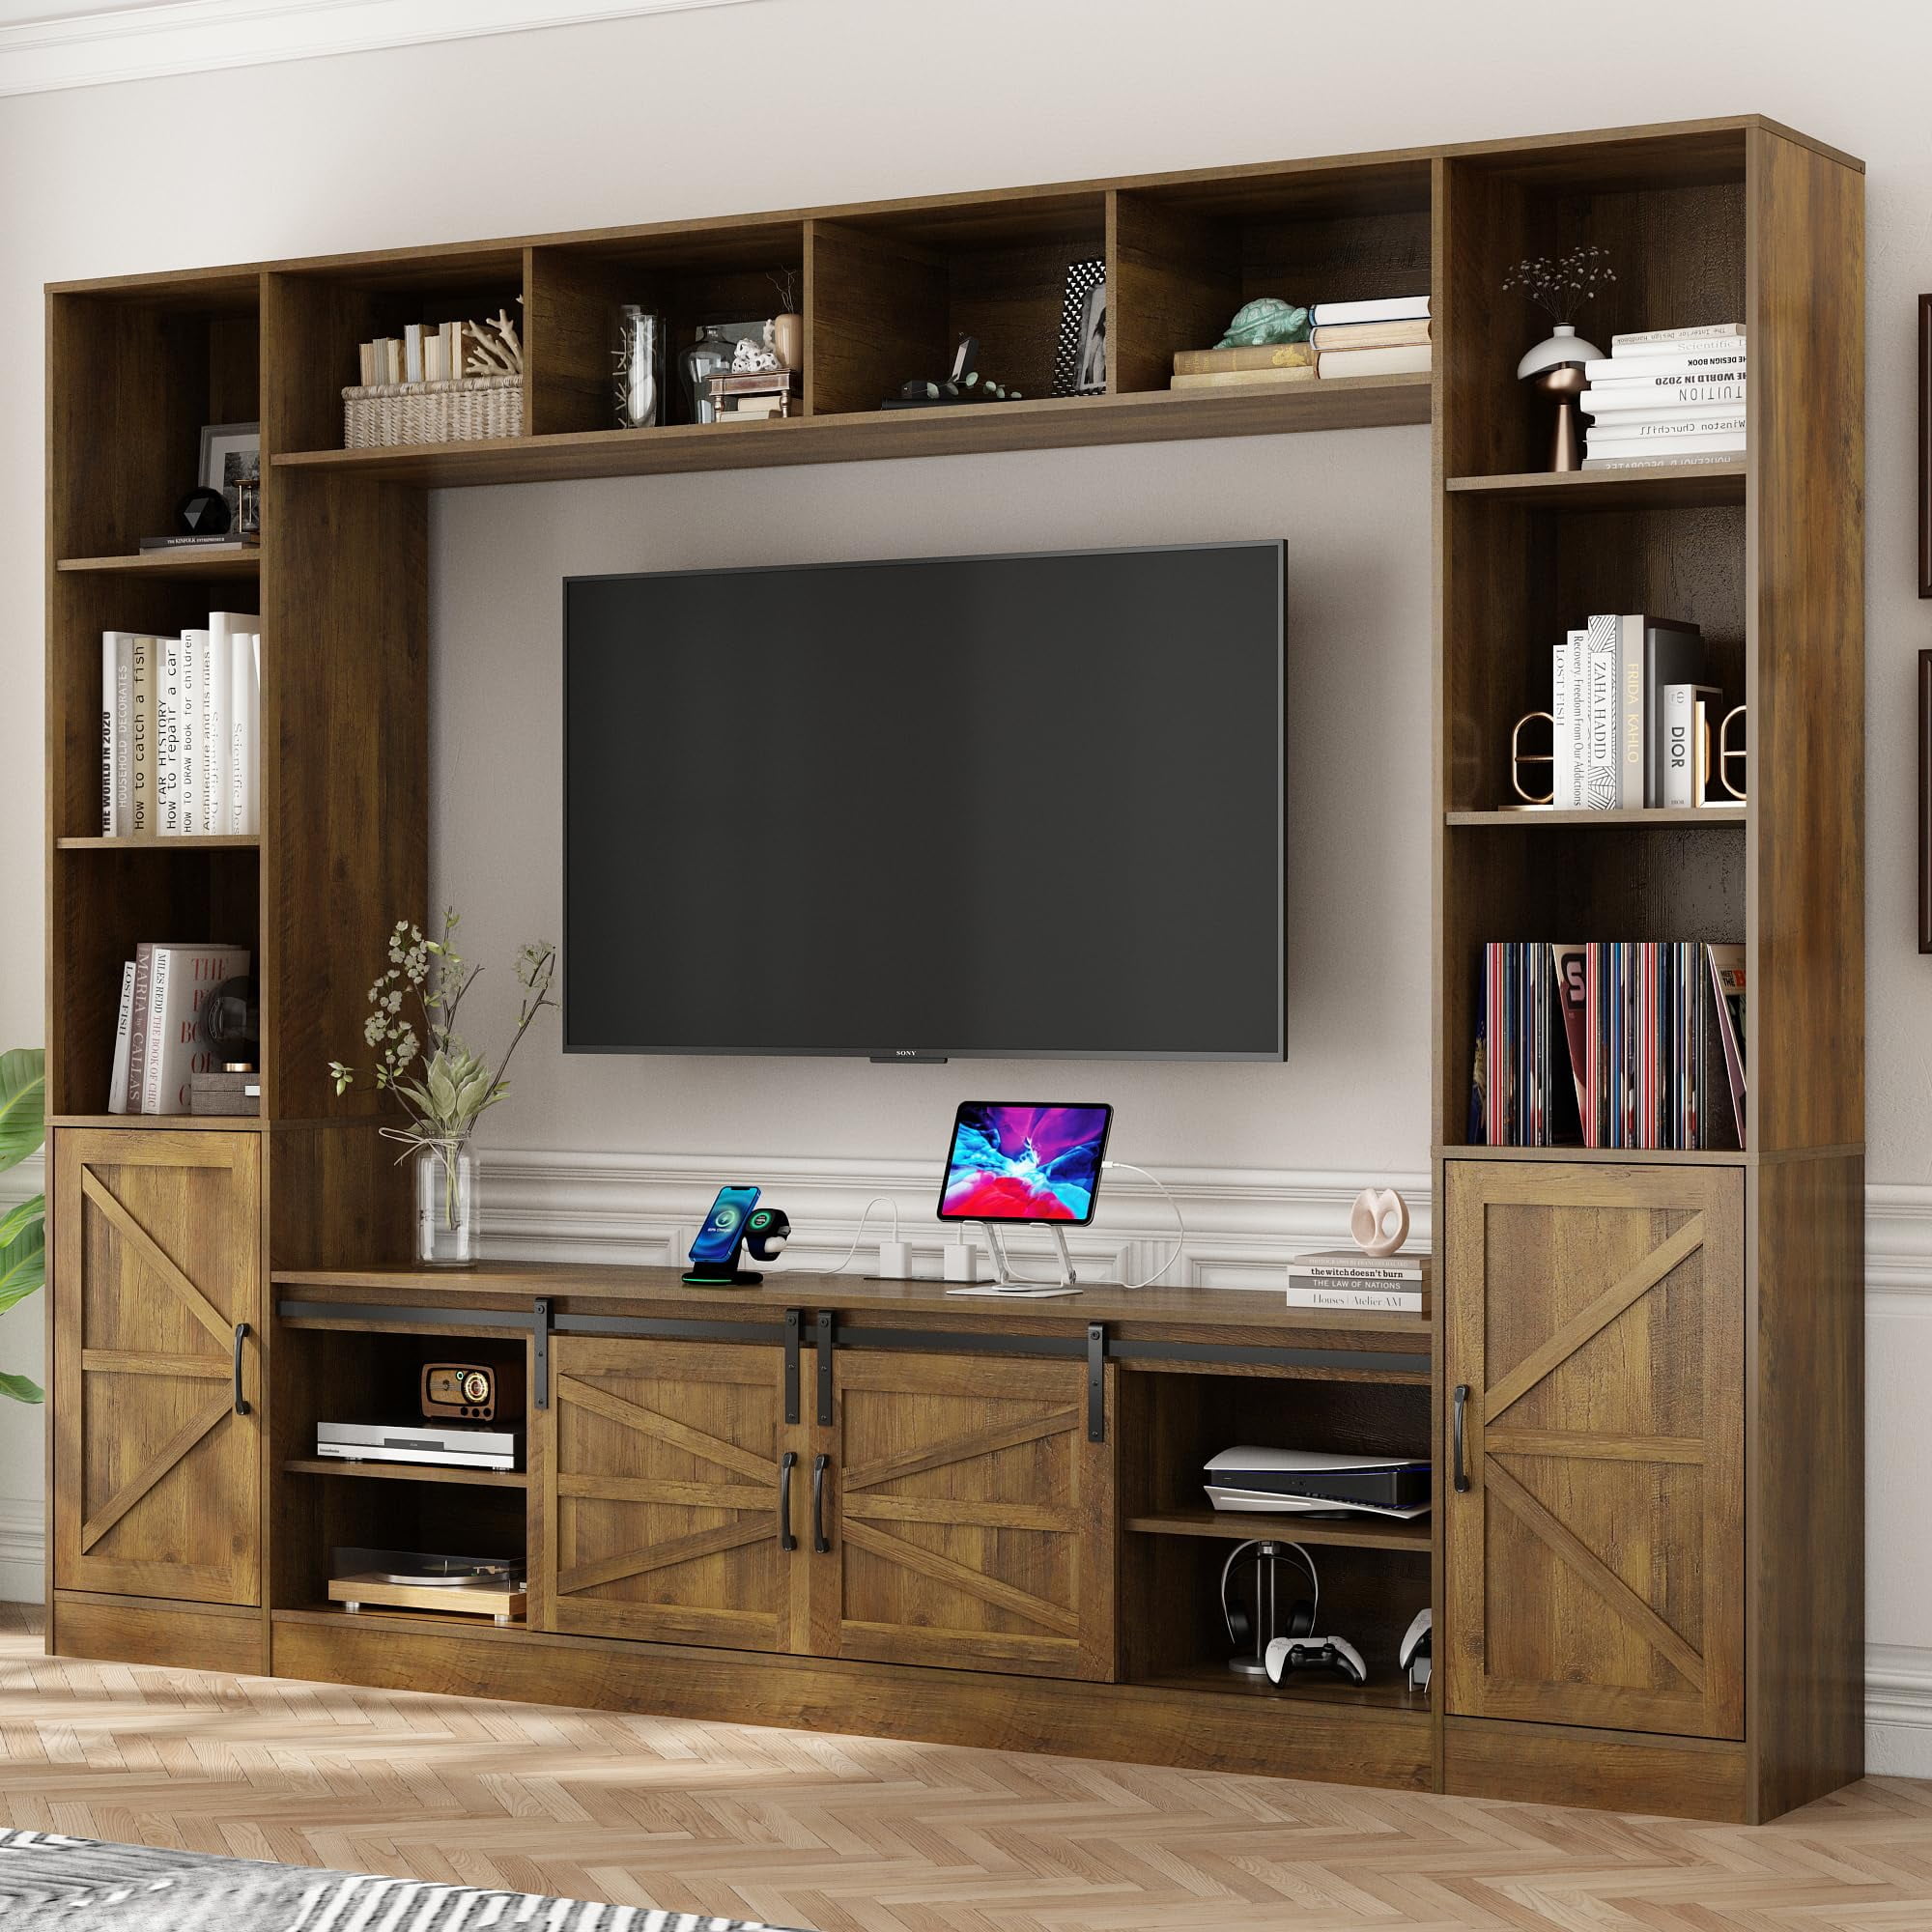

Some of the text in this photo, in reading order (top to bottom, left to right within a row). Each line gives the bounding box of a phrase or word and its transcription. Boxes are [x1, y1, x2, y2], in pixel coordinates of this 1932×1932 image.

[1688, 358, 1708, 367] BOOK
[1698, 373, 1735, 383] WORLD
[1710, 356, 1737, 365] DESIGN
[1655, 377, 1682, 386] 2020
[168, 687, 176, 696] a
[1555, 649, 1565, 726] LOST FISH
[1574, 679, 1584, 717] Freedom
[1574, 719, 1584, 741] From
[1594, 662, 1605, 759] ZAHA HADID
[1627, 664, 1638, 763] FRIDA KAHLO
[118, 665, 128, 808] HOUSEHOLD DECORATES
[134, 646, 145, 830] How to catch a fish
[166, 706, 180, 762] repair
[1574, 742, 1584, 759] Our
[1671, 726, 1685, 768] DIOR
[102, 711, 111, 833] THE WORLD IN 2020
[166, 773, 176, 790] to
[1573, 761, 1584, 807] Addictions
[166, 801, 176, 829] How
[184, 792, 191, 804] TO
[119, 965, 133, 1036] LOST FISH
[135, 953, 149, 1013] MARIA
[147, 953, 166, 1107] MILES REDD THE BOOK OF CHIC
[129, 1033, 143, 1101] CALLAS
[1325, 1268, 1350, 1277] witch
[1383, 1270, 1404, 1279] burn
[1314, 1293, 1345, 1304] Houses
[1353, 1295, 1382, 1306] Atelier
